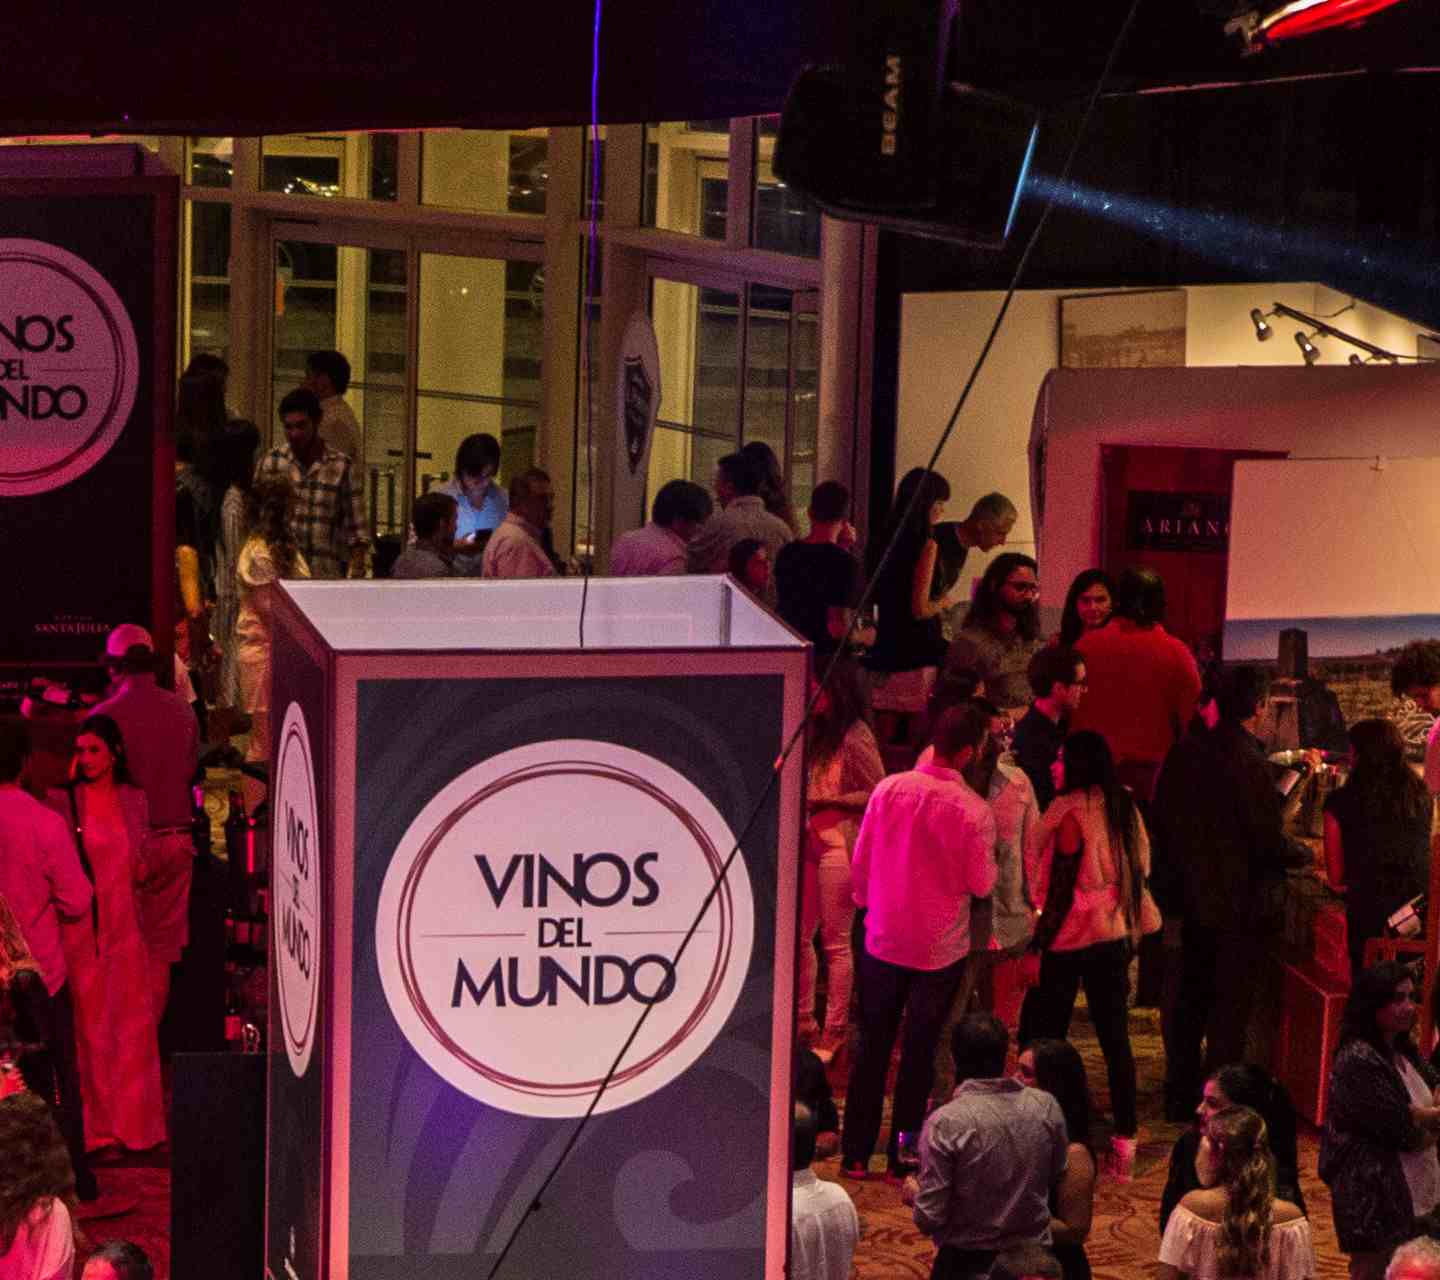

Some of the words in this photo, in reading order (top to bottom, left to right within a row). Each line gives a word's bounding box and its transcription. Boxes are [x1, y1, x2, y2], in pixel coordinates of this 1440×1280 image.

[474, 852, 660, 909] VINOS
[537, 917, 592, 947] DEL
[450, 953, 677, 1008] MUNDO
